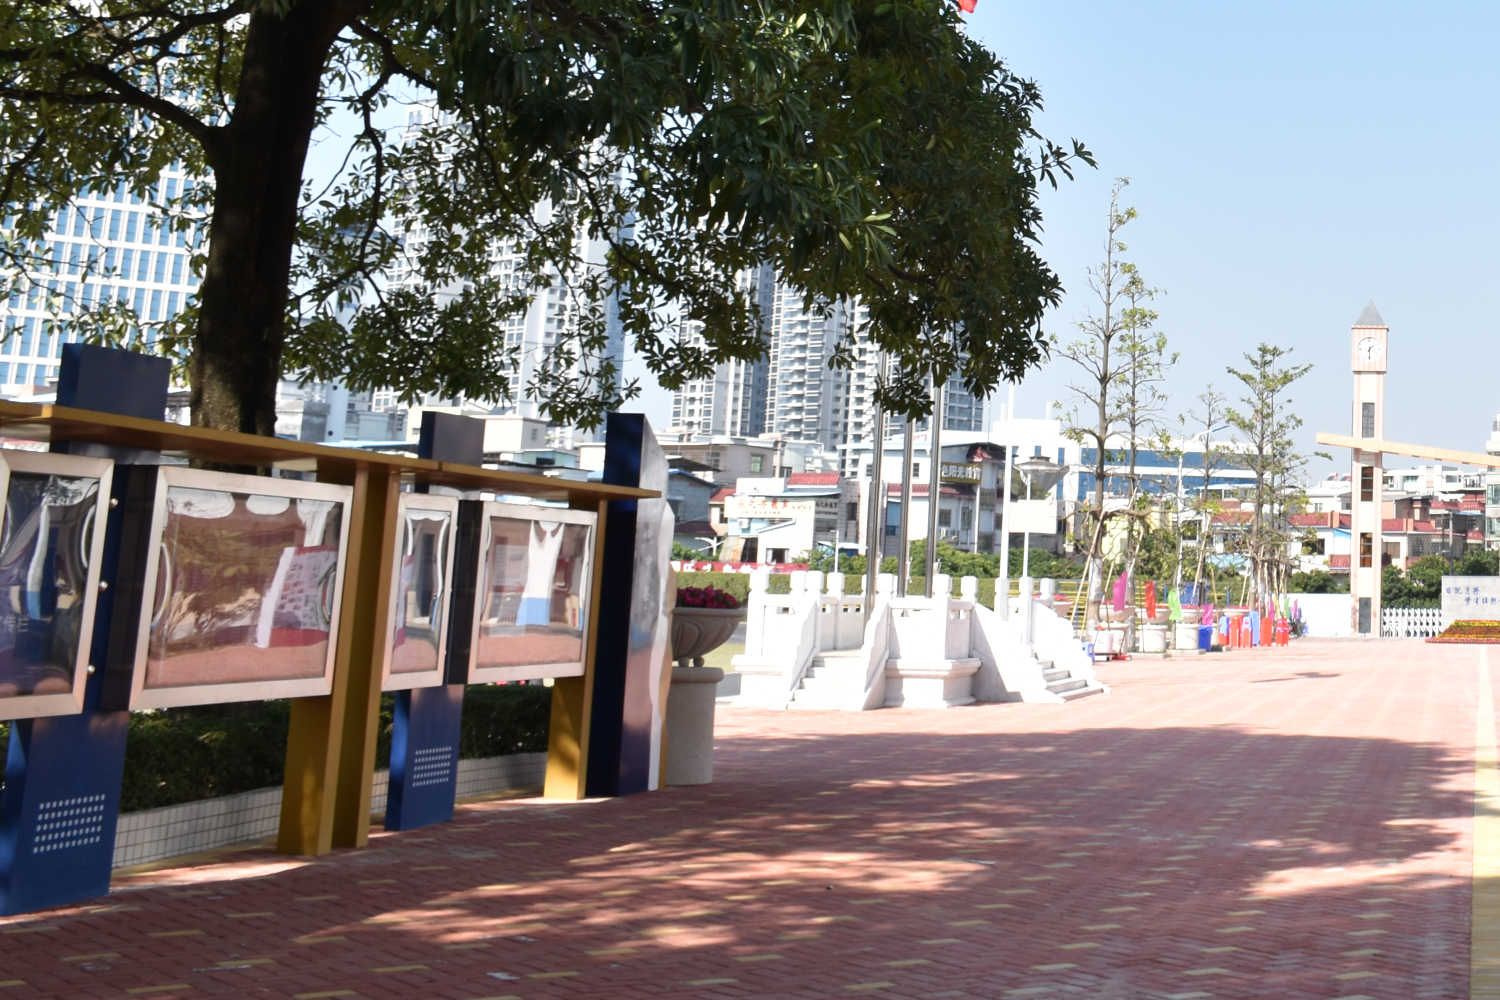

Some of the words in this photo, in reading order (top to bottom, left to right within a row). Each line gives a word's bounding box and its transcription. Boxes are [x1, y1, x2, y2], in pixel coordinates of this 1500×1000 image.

[941, 464, 982, 480] 色阳光教育
[0, 613, 30, 633] 传栏
